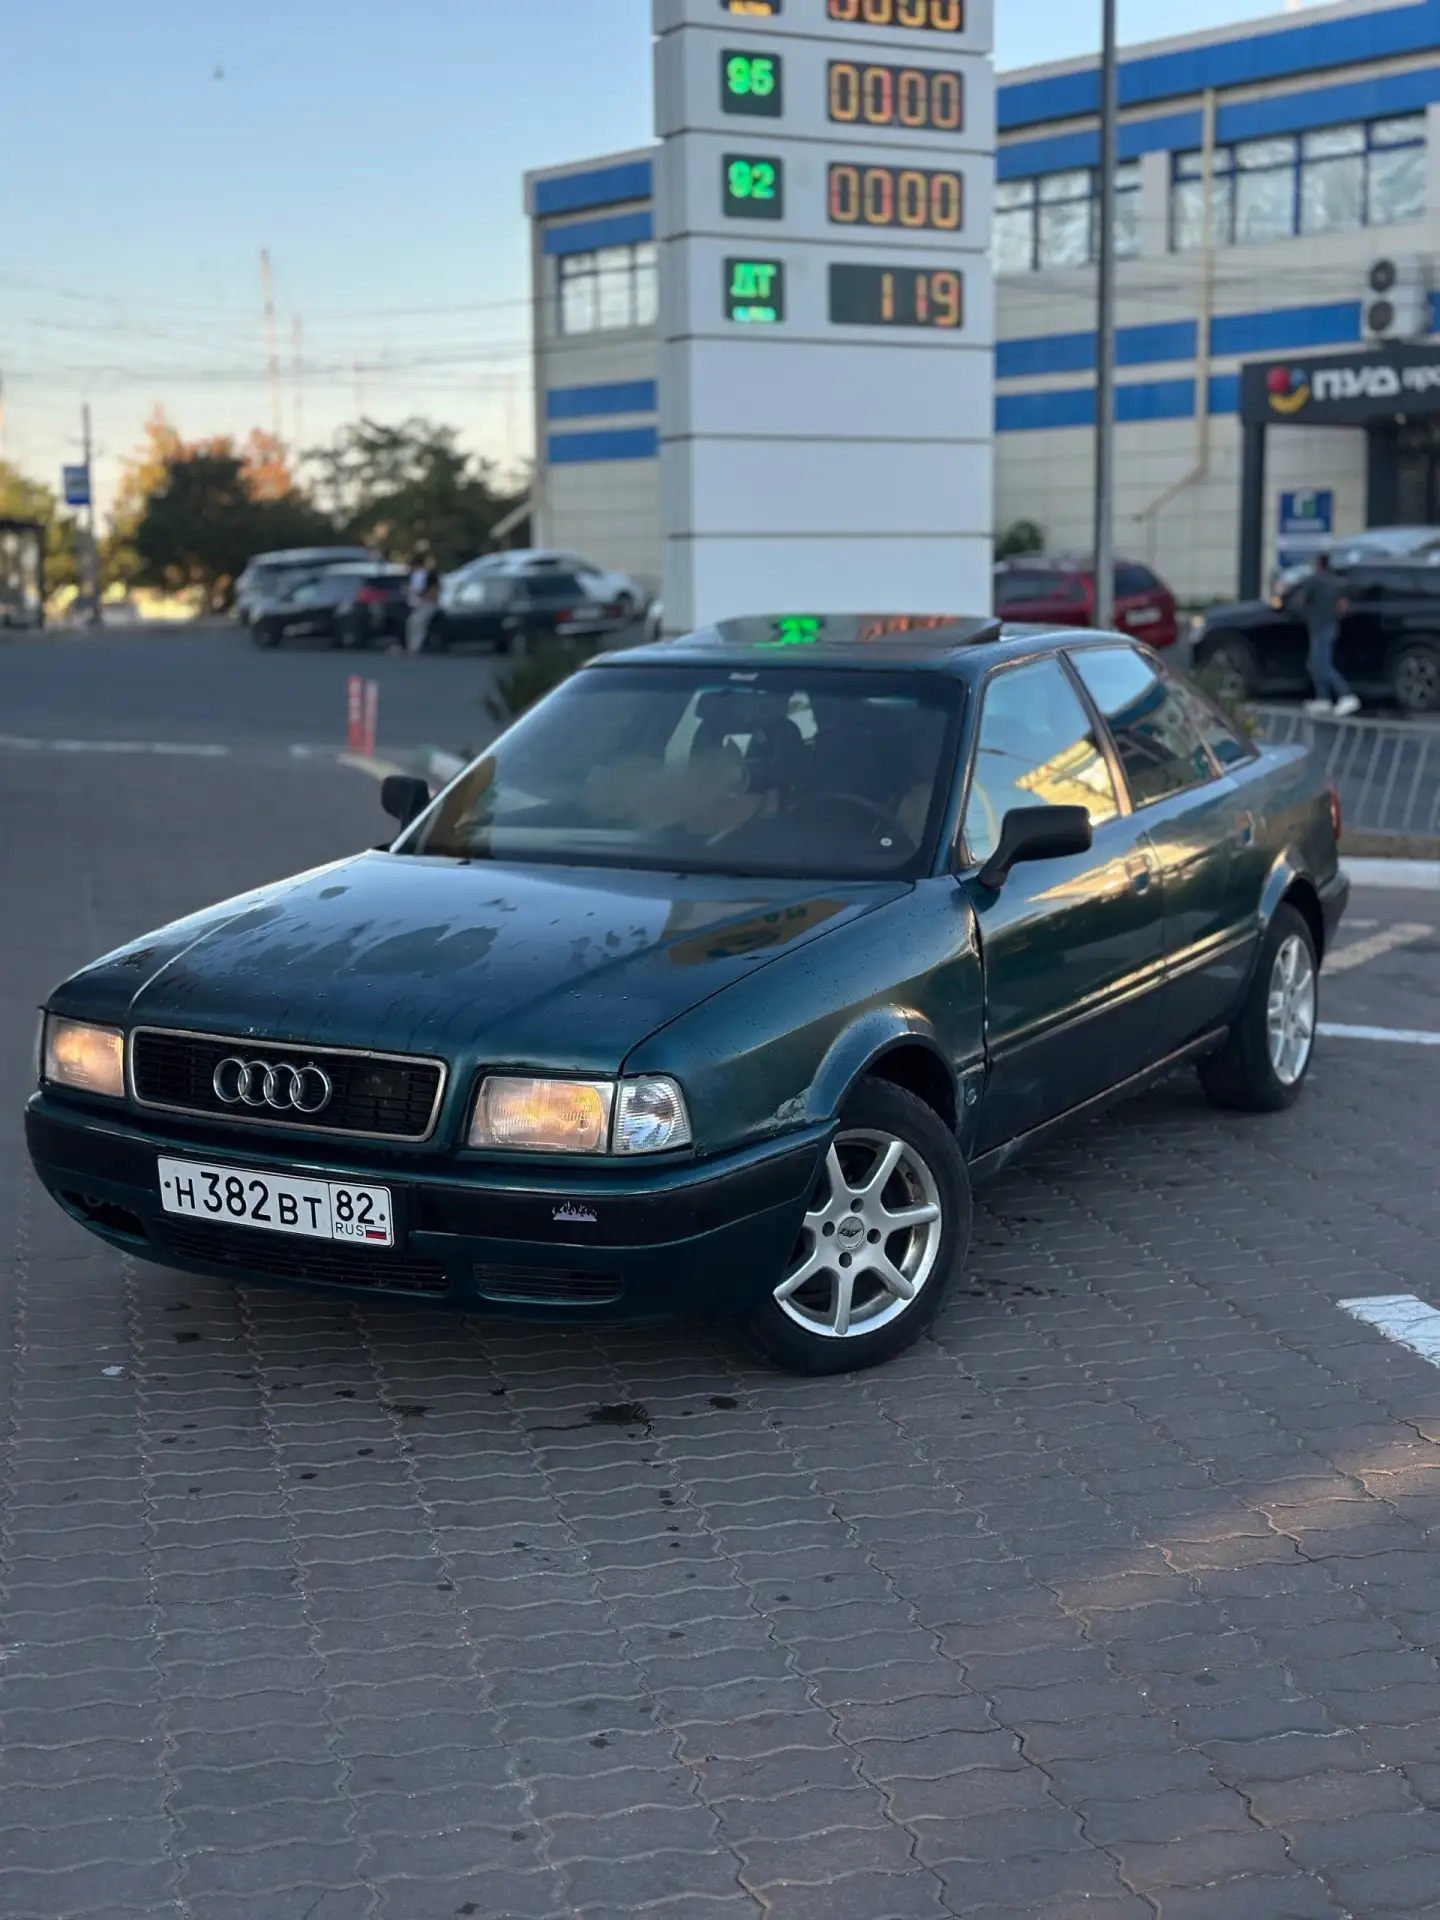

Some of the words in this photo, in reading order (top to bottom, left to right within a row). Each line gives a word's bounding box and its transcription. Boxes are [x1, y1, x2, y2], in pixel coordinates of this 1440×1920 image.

[830, 63, 960, 129] 0000
[830, 166, 961, 229] 0000
[335, 1221, 365, 1237] RUS
